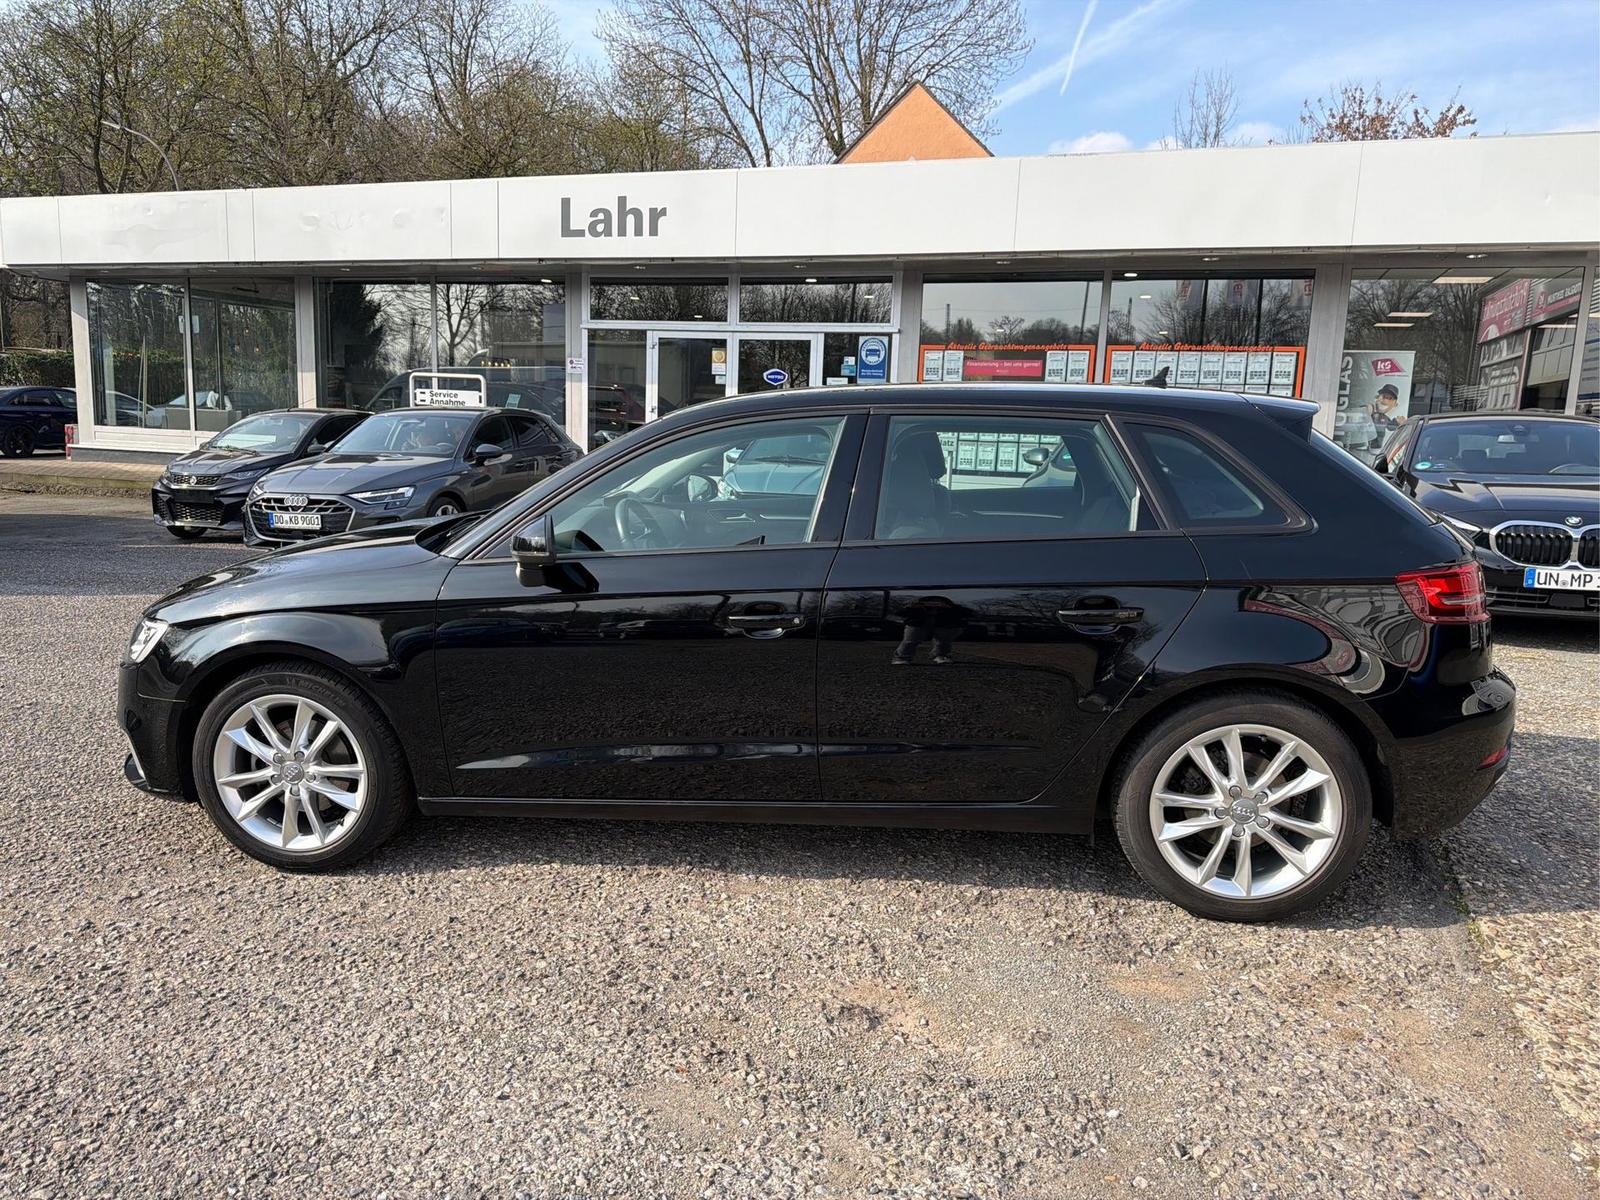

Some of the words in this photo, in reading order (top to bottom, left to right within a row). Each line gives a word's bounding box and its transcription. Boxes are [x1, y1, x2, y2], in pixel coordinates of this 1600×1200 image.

[561, 195, 668, 238] Lahr
[946, 341, 977, 350] Aktuelle
[978, 342, 1068, 352] Gebrauchtwagenangebote
[1138, 342, 1172, 351] Aktuelle
[1173, 342, 1273, 352] Gebrauchtwagenangebote
[429, 390, 458, 399] Service
[429, 398, 466, 406] Annahme
[274, 514, 284, 525] DO
[289, 515, 300, 525] KB
[1537, 571, 1560, 586] UN
[1570, 573, 1593, 588] MP
